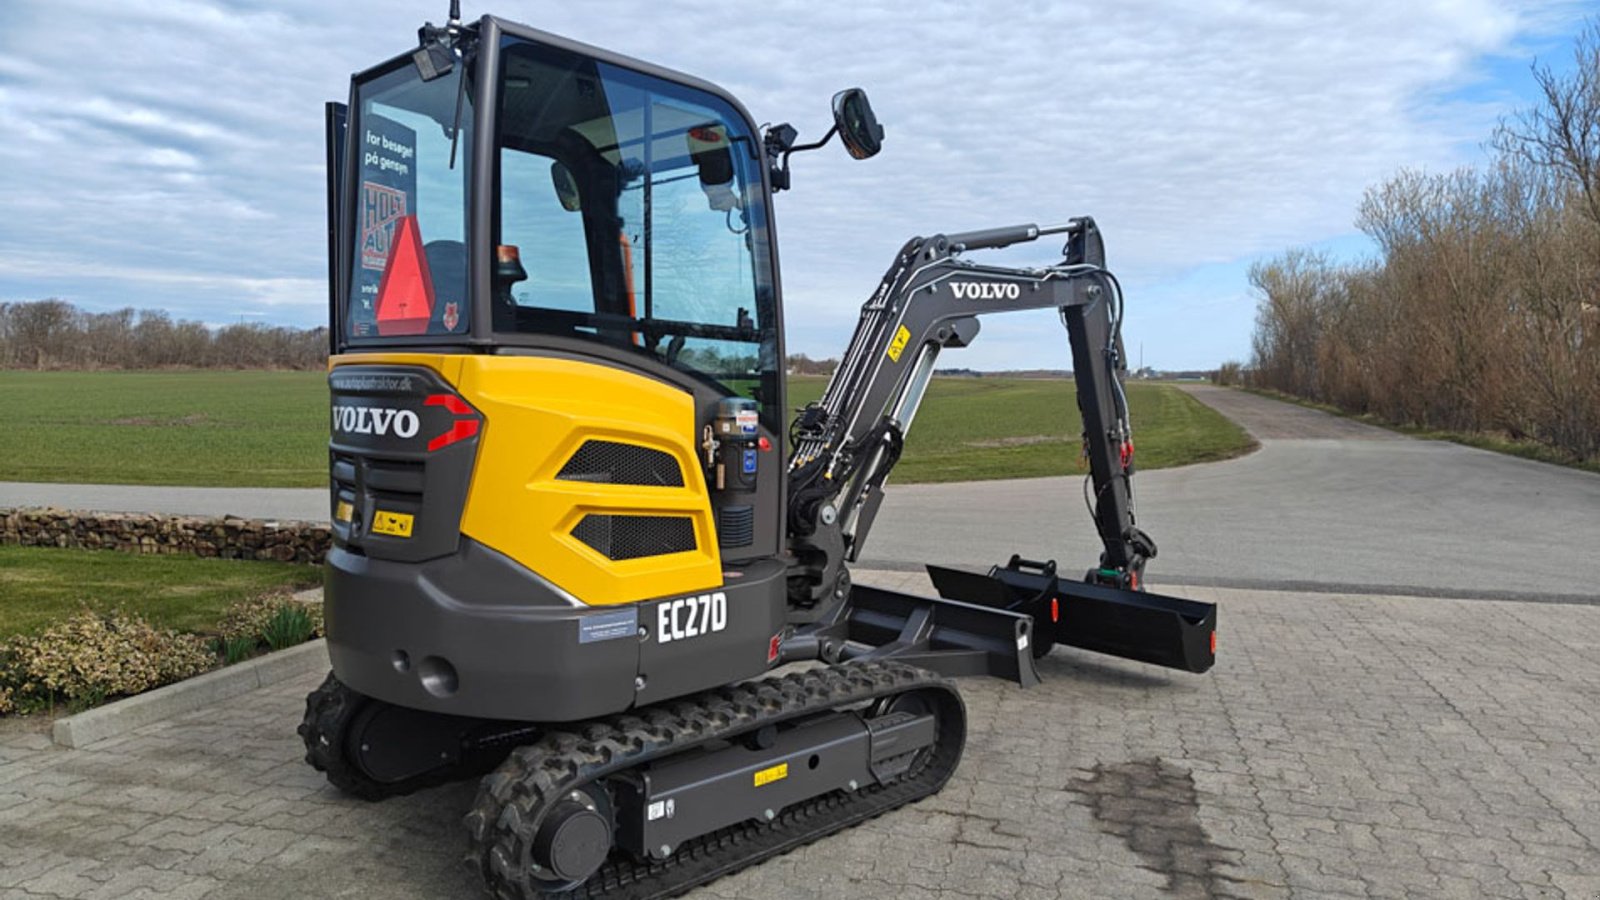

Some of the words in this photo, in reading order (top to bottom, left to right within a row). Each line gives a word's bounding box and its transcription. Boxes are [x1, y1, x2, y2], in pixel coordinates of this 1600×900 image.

[364, 151, 379, 166] på
[949, 282, 1020, 299] VOLVO
[332, 406, 420, 438] VOLVO
[657, 592, 727, 643] EC27D
